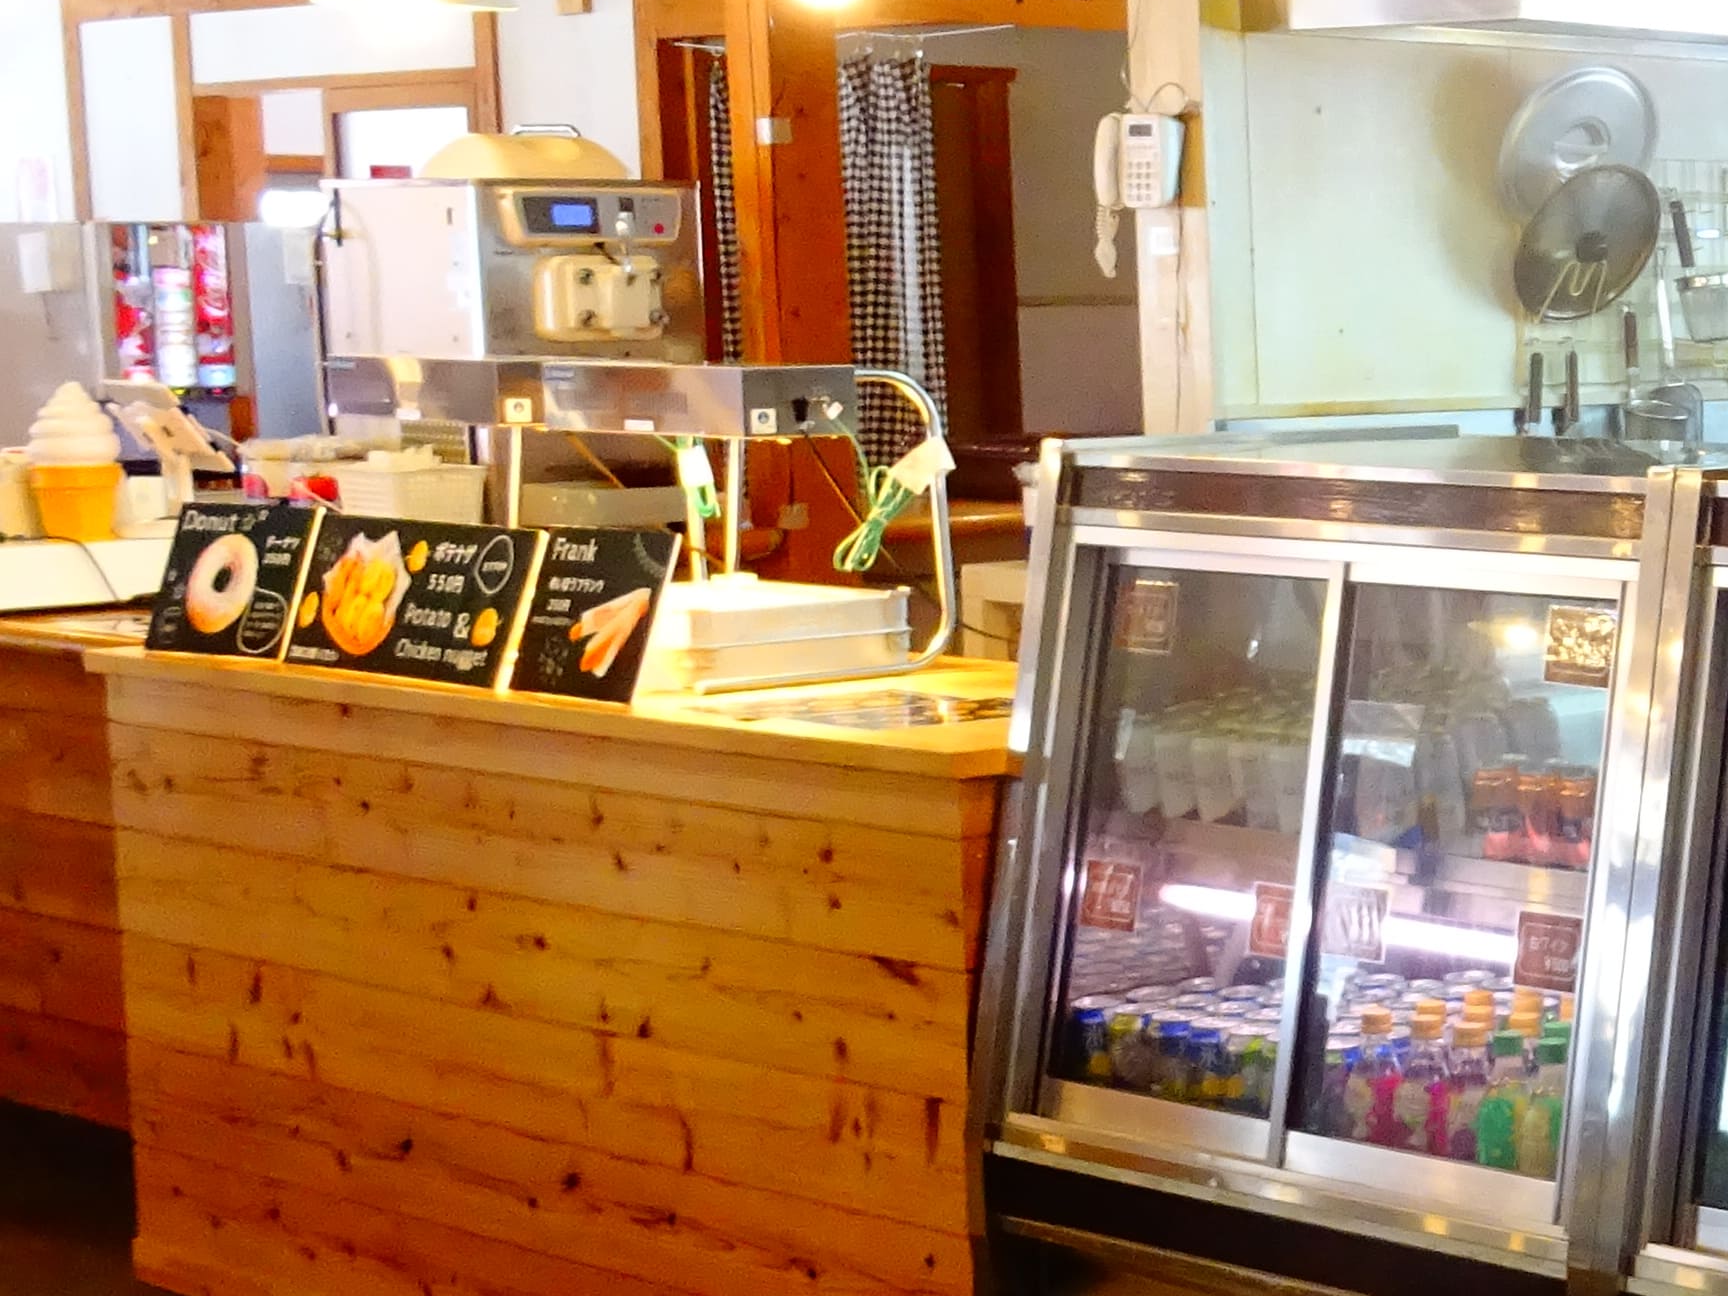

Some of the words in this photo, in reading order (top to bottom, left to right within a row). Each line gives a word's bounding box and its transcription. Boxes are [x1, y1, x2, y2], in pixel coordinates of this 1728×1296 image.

[181, 509, 239, 532] Donut
[551, 536, 599, 562] Frank
[404, 602, 451, 629] Potato
[453, 612, 471, 639] &
